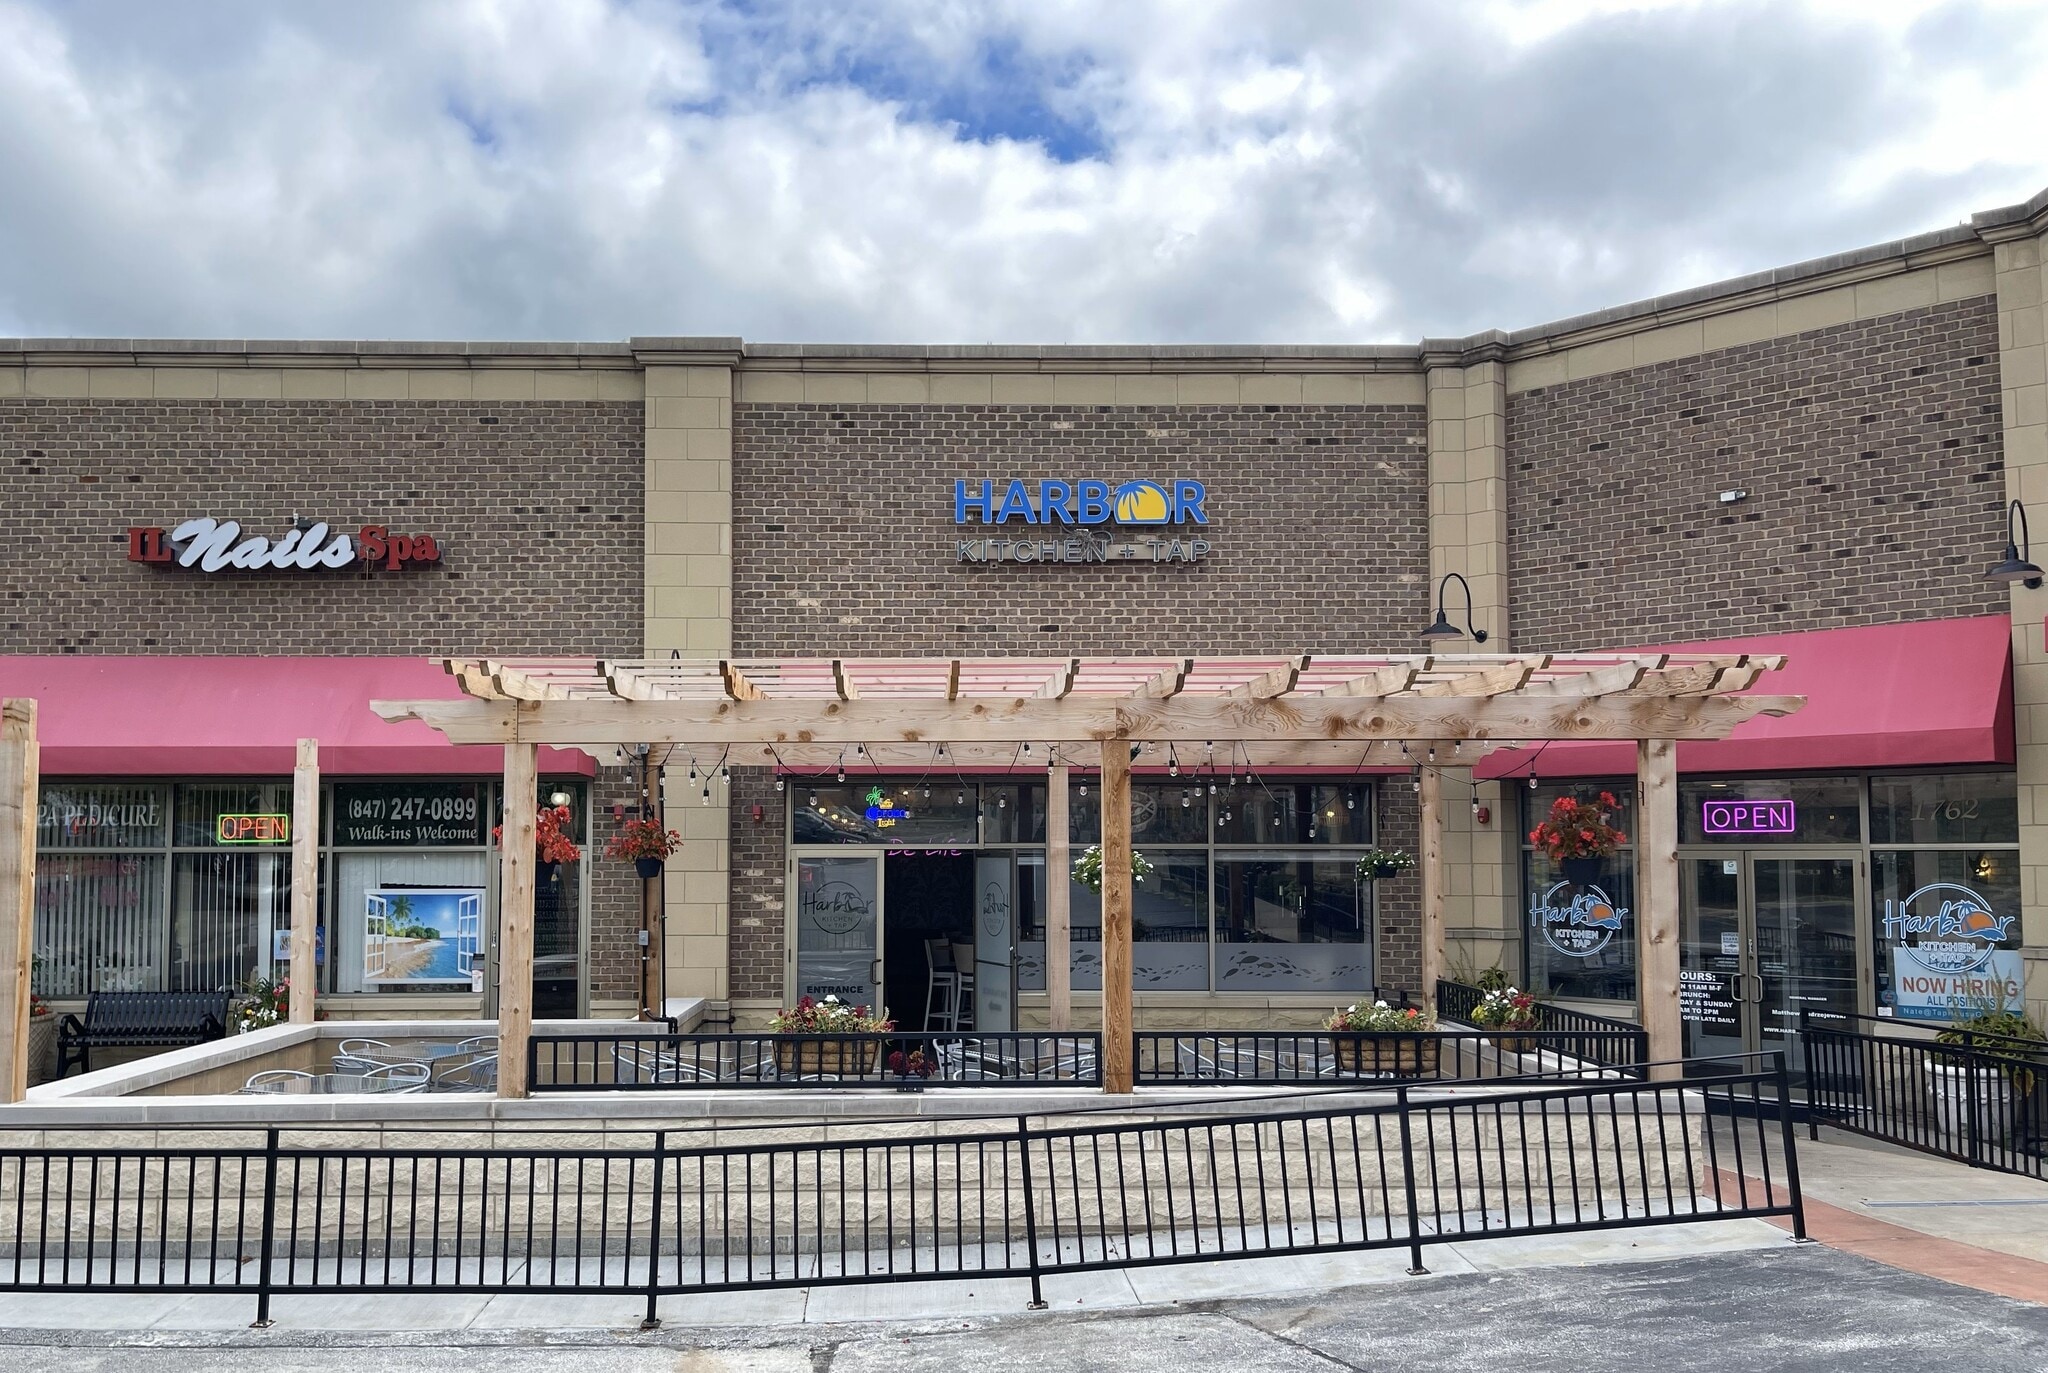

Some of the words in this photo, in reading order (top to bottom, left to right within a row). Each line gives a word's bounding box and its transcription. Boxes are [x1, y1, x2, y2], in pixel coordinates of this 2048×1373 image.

[955, 479, 1209, 525] HARBOR
[127, 527, 174, 563] IL
[171, 517, 356, 573] Nails
[359, 525, 441, 571] Spa
[955, 538, 1108, 563] KITCHEN
[1149, 538, 1211, 563] TAP
[37, 804, 59, 827] PA
[64, 804, 160, 827] PEDICURE
[349, 799, 386, 820] (847)
[390, 797, 477, 821] 247-0899
[1710, 807, 1787, 829] OPEN
[1910, 798, 1980, 821] 1762
[220, 816, 286, 840] OPEN
[349, 825, 411, 840] Walk-ins
[416, 824, 478, 840] Welcome
[1529, 892, 1628, 929] Harbor
[1882, 899, 2015, 941] Harbor
[1555, 928, 1599, 940] KITCHEN
[1572, 938, 1592, 948] TAP
[1918, 941, 1976, 953] KITCHEN
[1941, 952, 1966, 963] TAP
[1680, 971, 1716, 981] OURS:
[1902, 976, 1946, 994] NOW
[807, 985, 863, 994] ENTRANCE
[1926, 995, 1944, 1006] ALL
